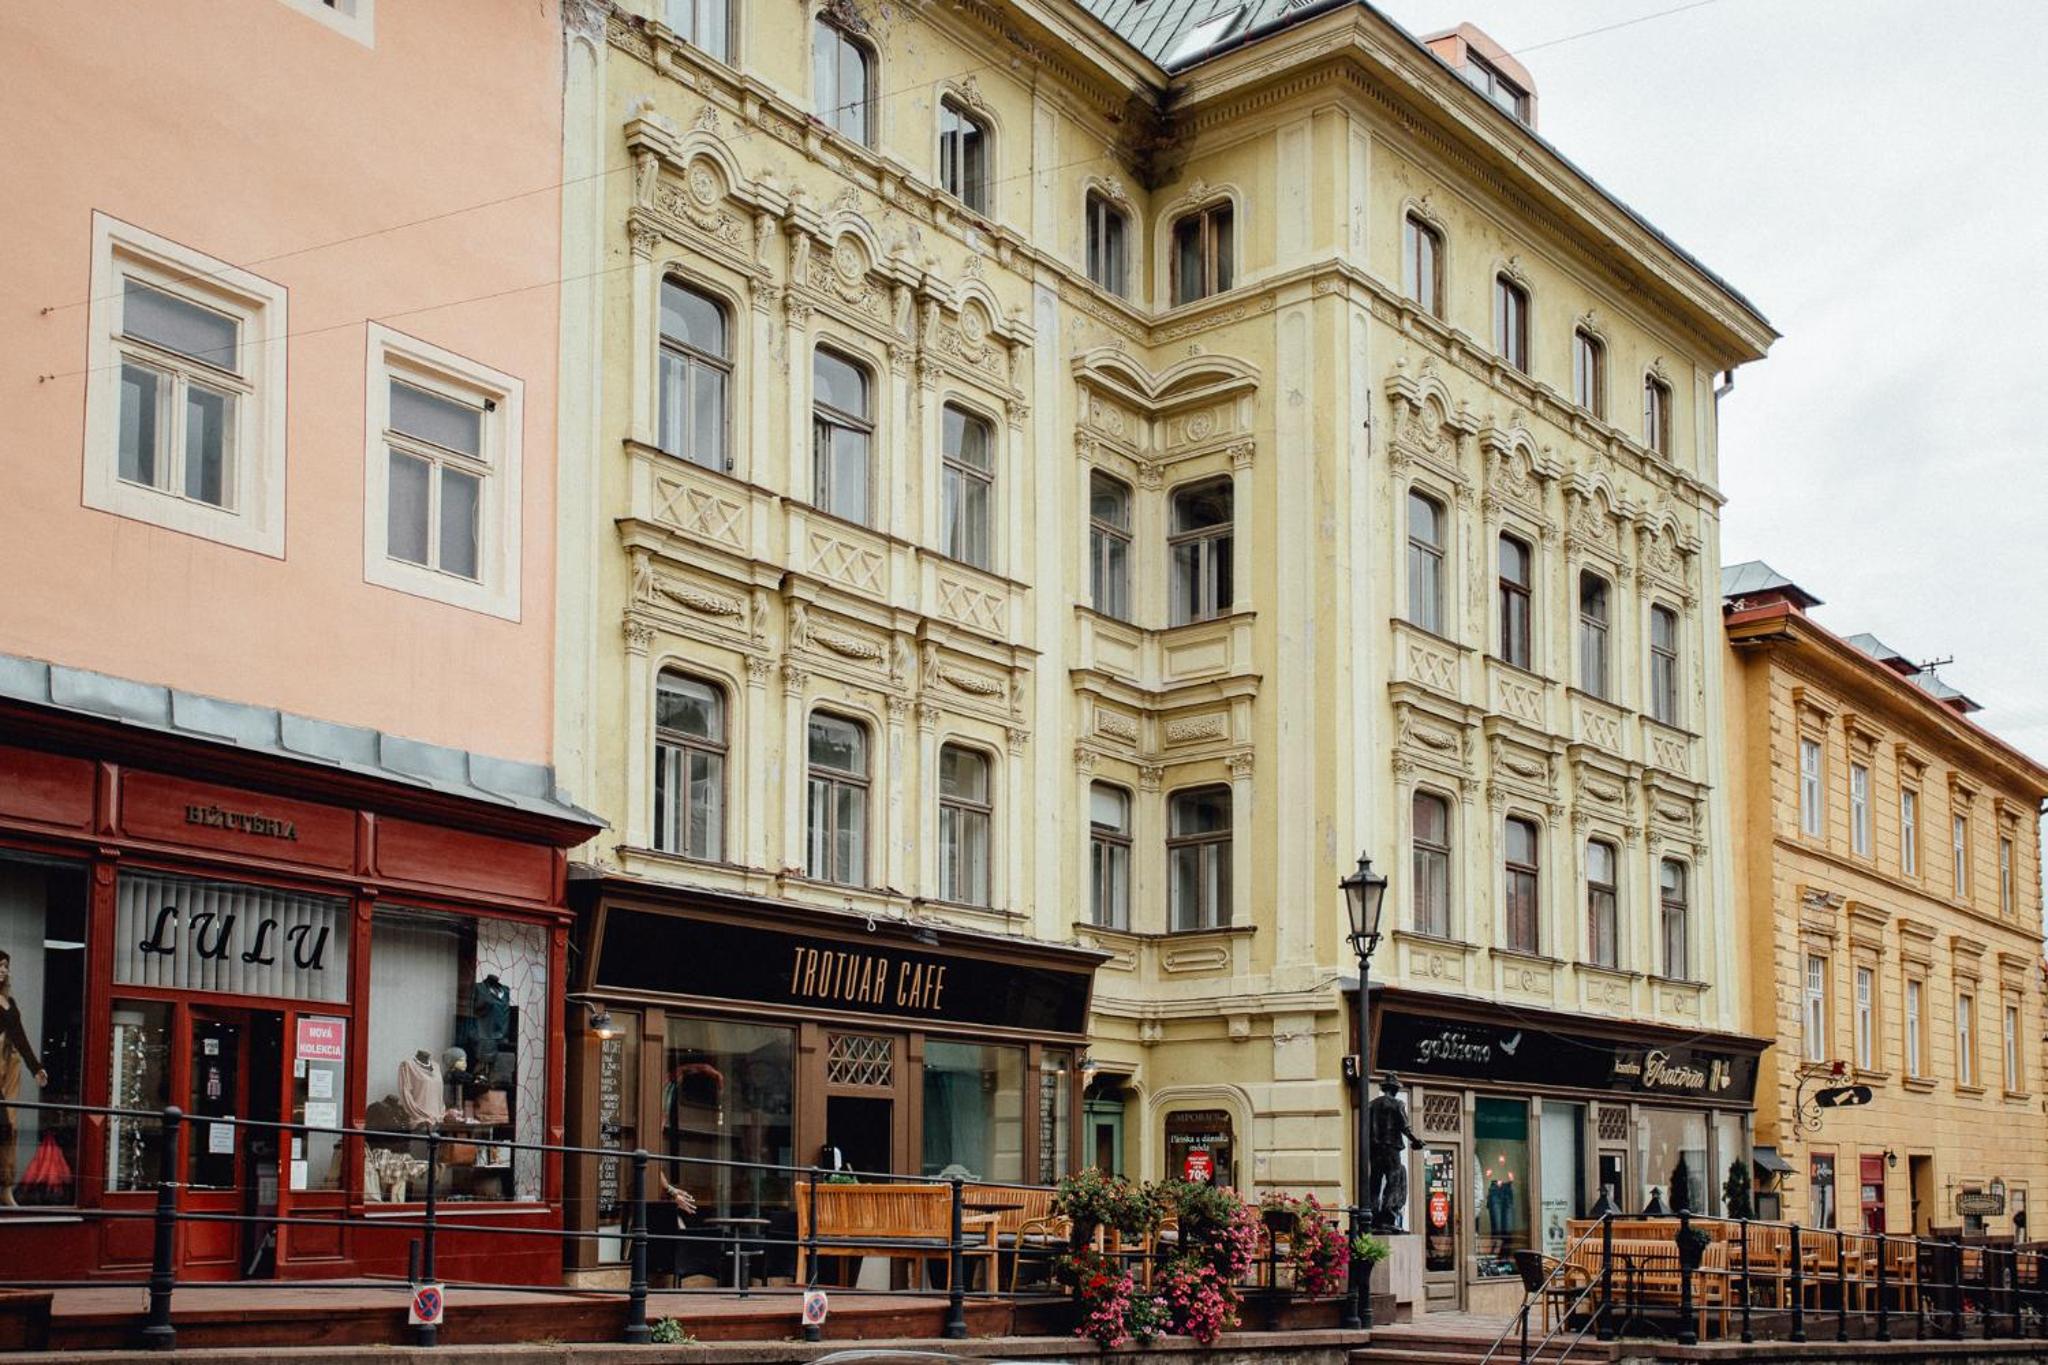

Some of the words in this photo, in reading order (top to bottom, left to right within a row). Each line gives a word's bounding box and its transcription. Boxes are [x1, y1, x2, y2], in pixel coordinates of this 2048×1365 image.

[139, 906, 329, 970] LULU
[791, 947, 888, 1004] TROTUAR
[897, 961, 947, 1010] CAFE
[309, 1025, 333, 1038] NOVÁ
[300, 1043, 341, 1056] KOLEKCIA
[1188, 1169, 1210, 1180] 70%
